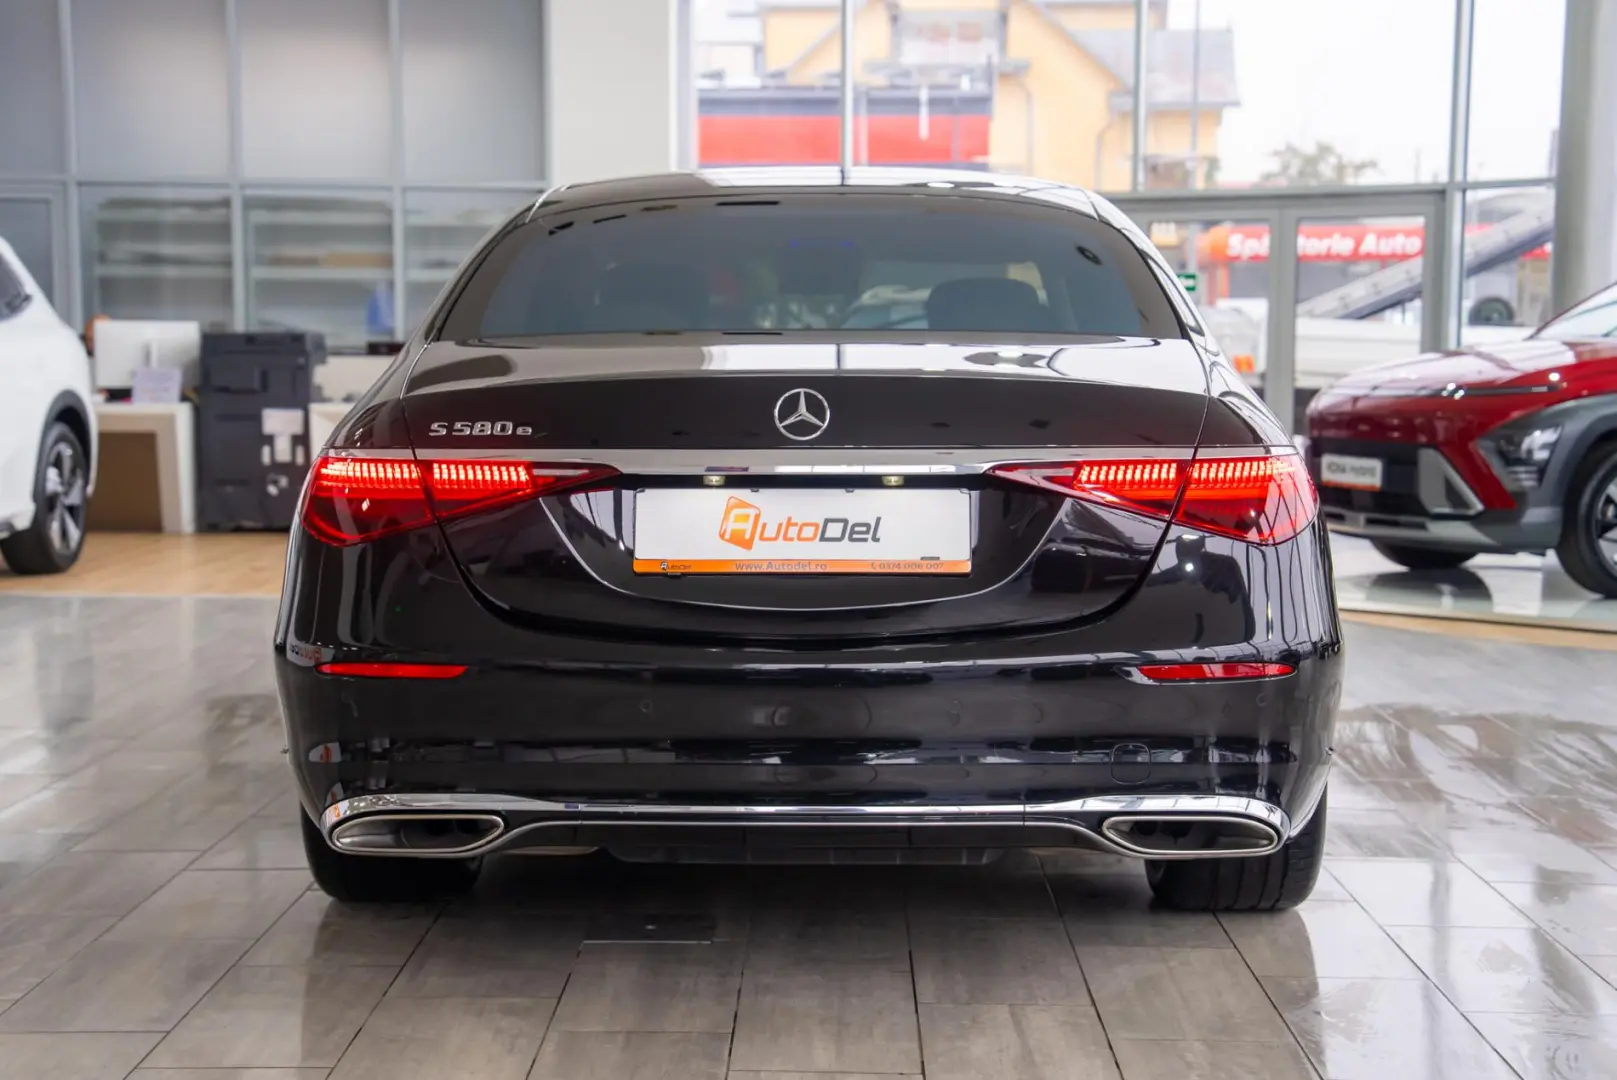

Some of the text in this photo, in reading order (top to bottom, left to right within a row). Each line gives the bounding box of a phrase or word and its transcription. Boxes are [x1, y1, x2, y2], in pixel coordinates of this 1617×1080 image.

[1359, 232, 1422, 256] Auto
[429, 422, 448, 436] S
[723, 506, 882, 544] AutoDel
